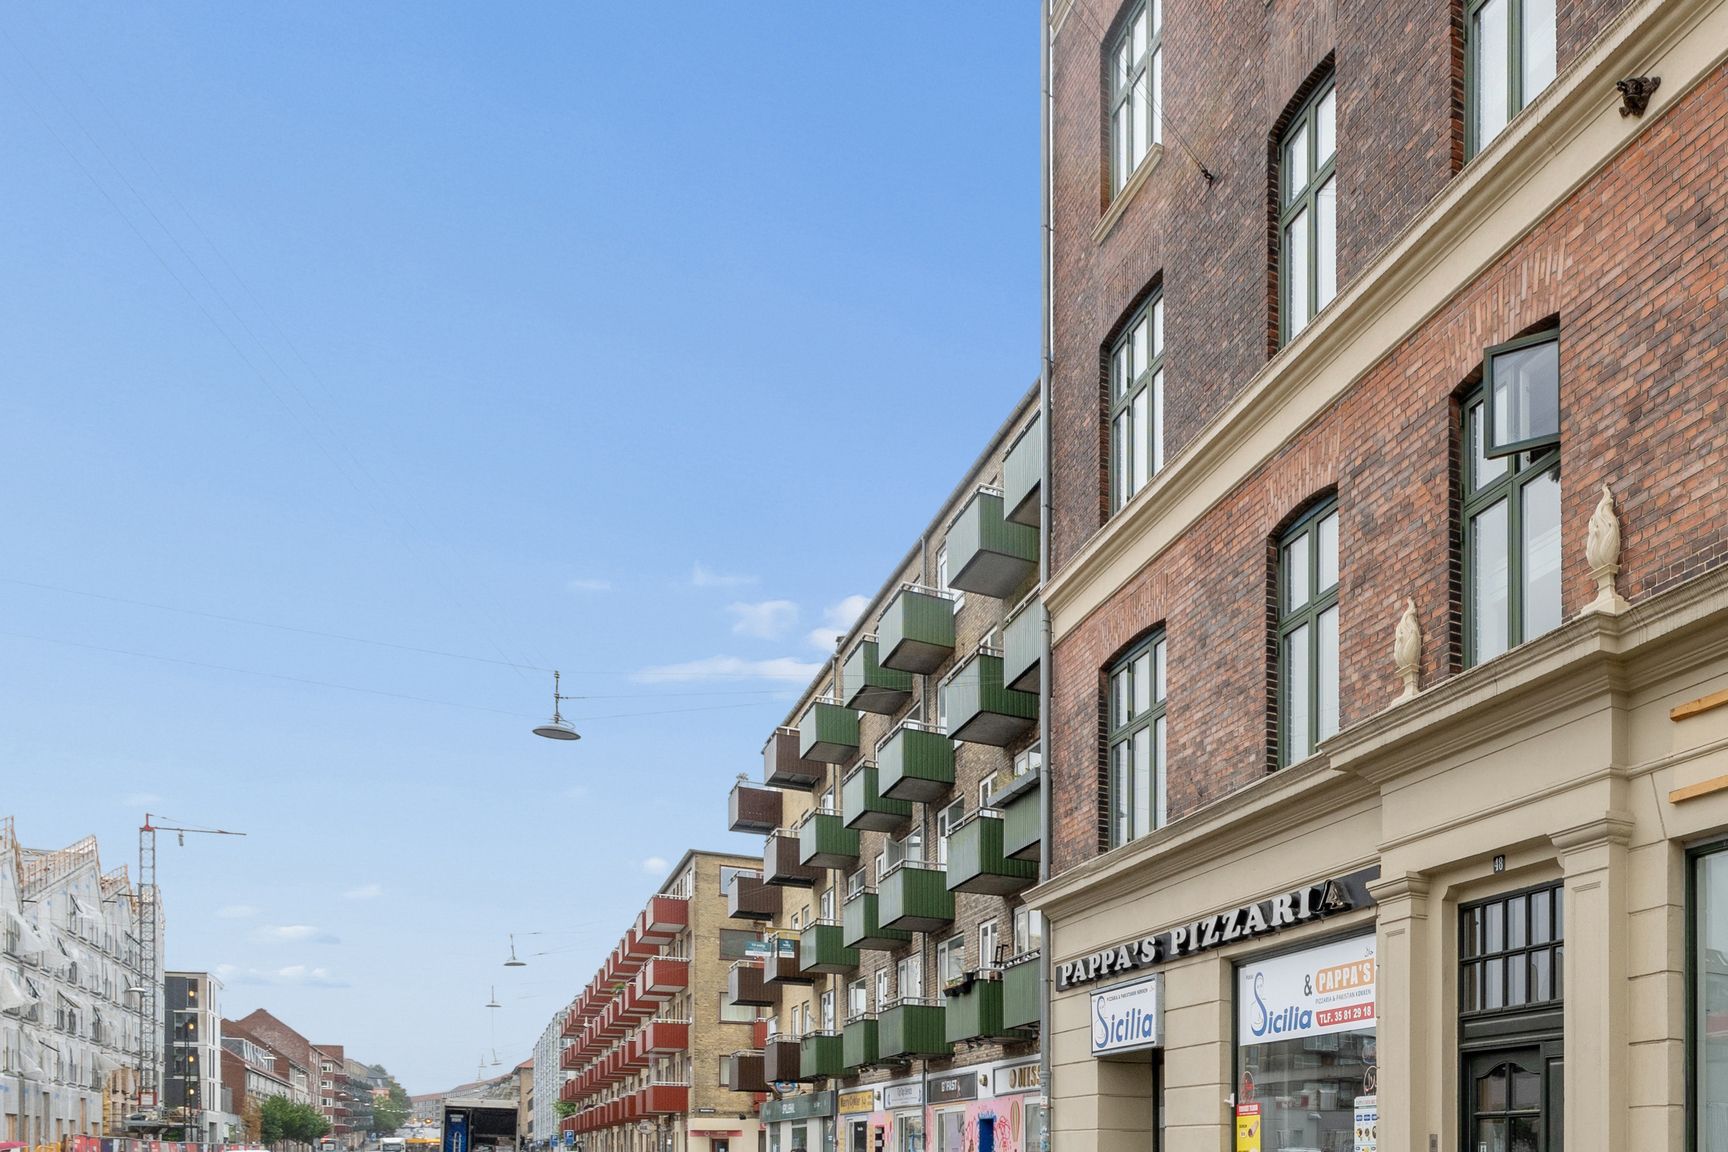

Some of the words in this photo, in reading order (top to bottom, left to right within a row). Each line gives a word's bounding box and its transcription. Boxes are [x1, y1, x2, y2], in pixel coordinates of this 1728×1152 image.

[1061, 936, 1157, 986] PAPPA'S
[1169, 879, 1348, 955] PIZZARIA
[1251, 972, 1313, 1036] Sicilia
[1304, 974, 1312, 996] &
[1318, 962, 1371, 992] PAPPA'S
[1095, 996, 1153, 1048] Sicilia
[1320, 1012, 1334, 1024] TLF.
[1334, 1010, 1343, 1022] 35
[1343, 1009, 1352, 1020] 81
[1353, 1007, 1362, 1019] 29
[1363, 1005, 1372, 1017] 18
